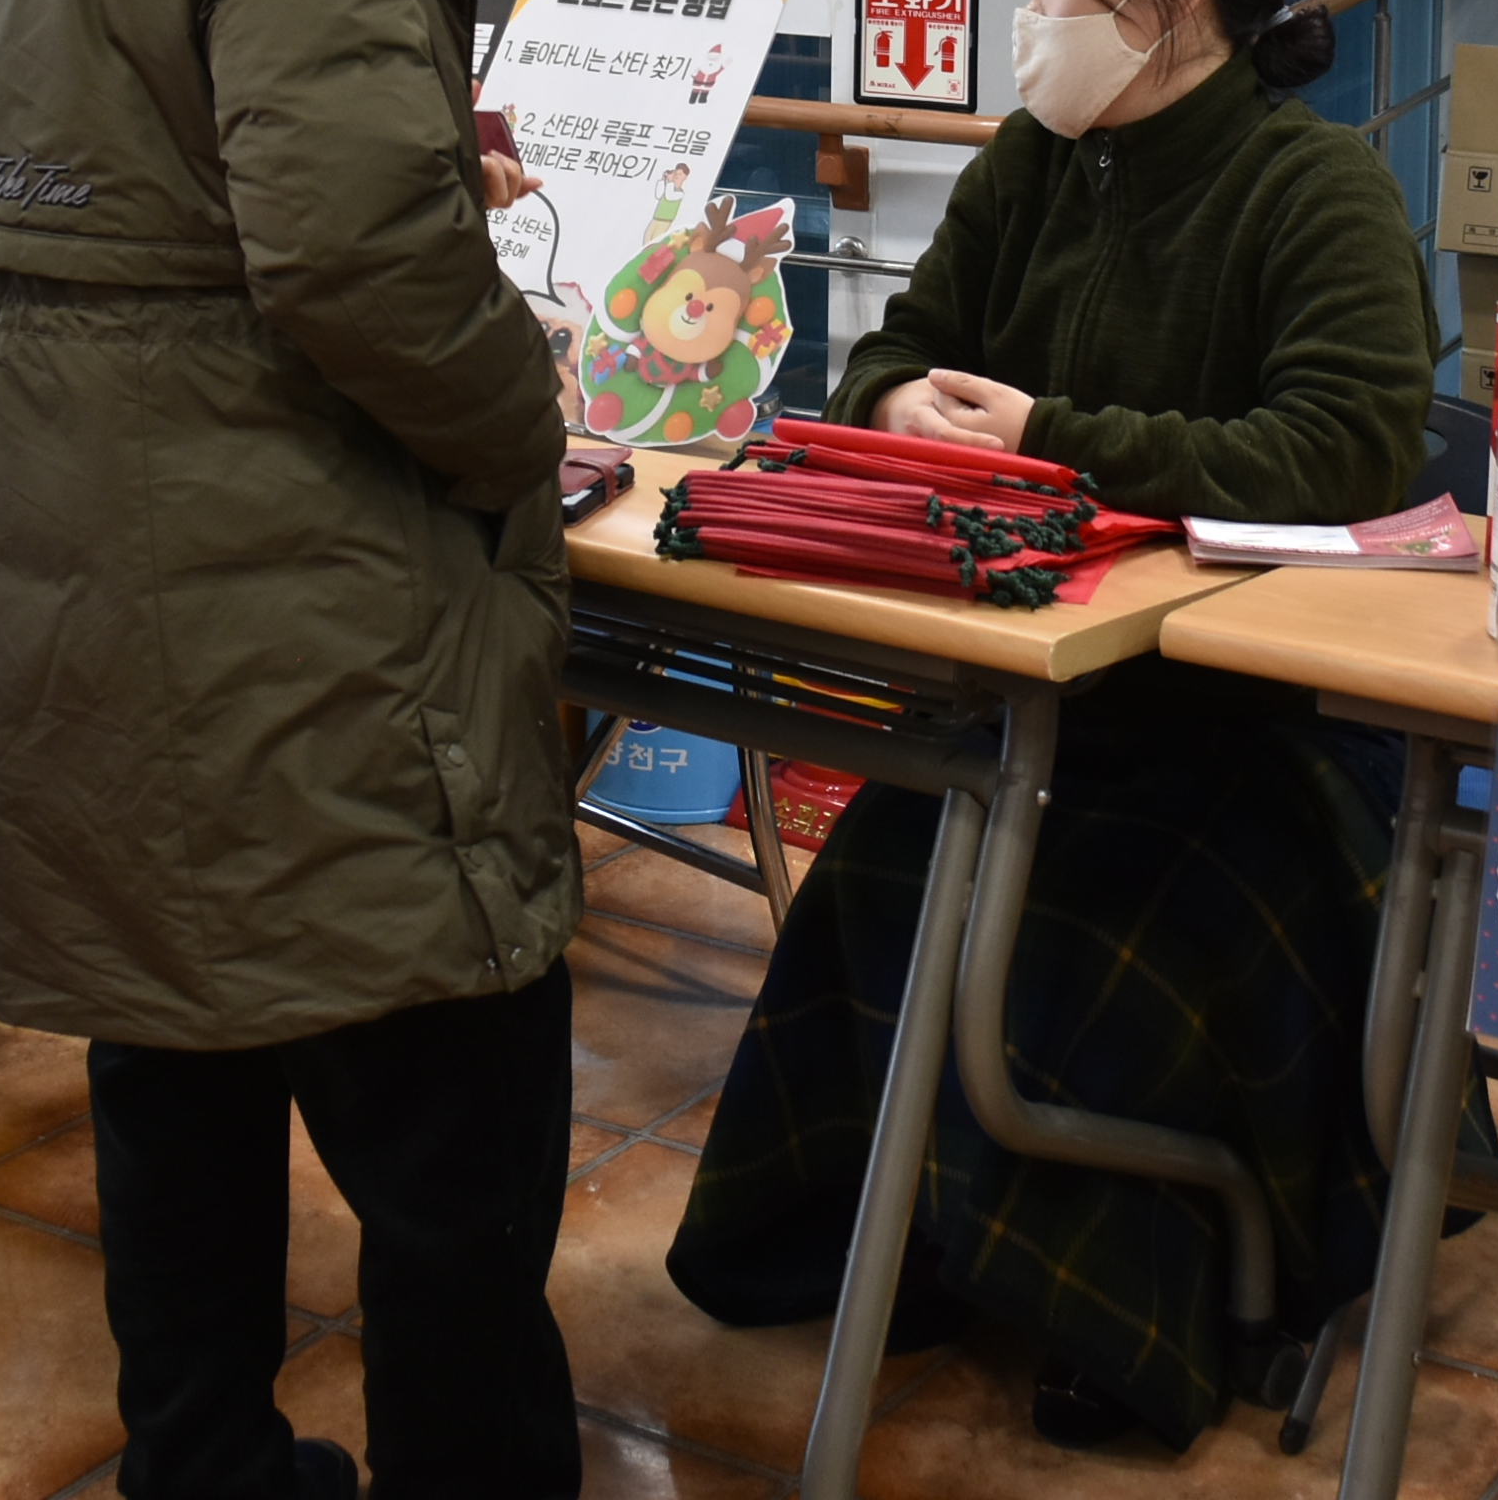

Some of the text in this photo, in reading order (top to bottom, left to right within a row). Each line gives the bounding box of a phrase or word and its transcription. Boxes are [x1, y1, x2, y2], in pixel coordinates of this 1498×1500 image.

[870, 7, 961, 20] FIRE EXTINGUISHER
[503, 40, 514, 64] 1.
[518, 40, 607, 74] 돌아다니는
[608, 51, 649, 76] 산타
[650, 54, 692, 80] 찾기
[520, 111, 712, 156] 2. 산타와 루돌프 그림을
[583, 149, 658, 182] 찍어오기
[20, 163, 94, 210] Time
[511, 214, 553, 242] 산타는
